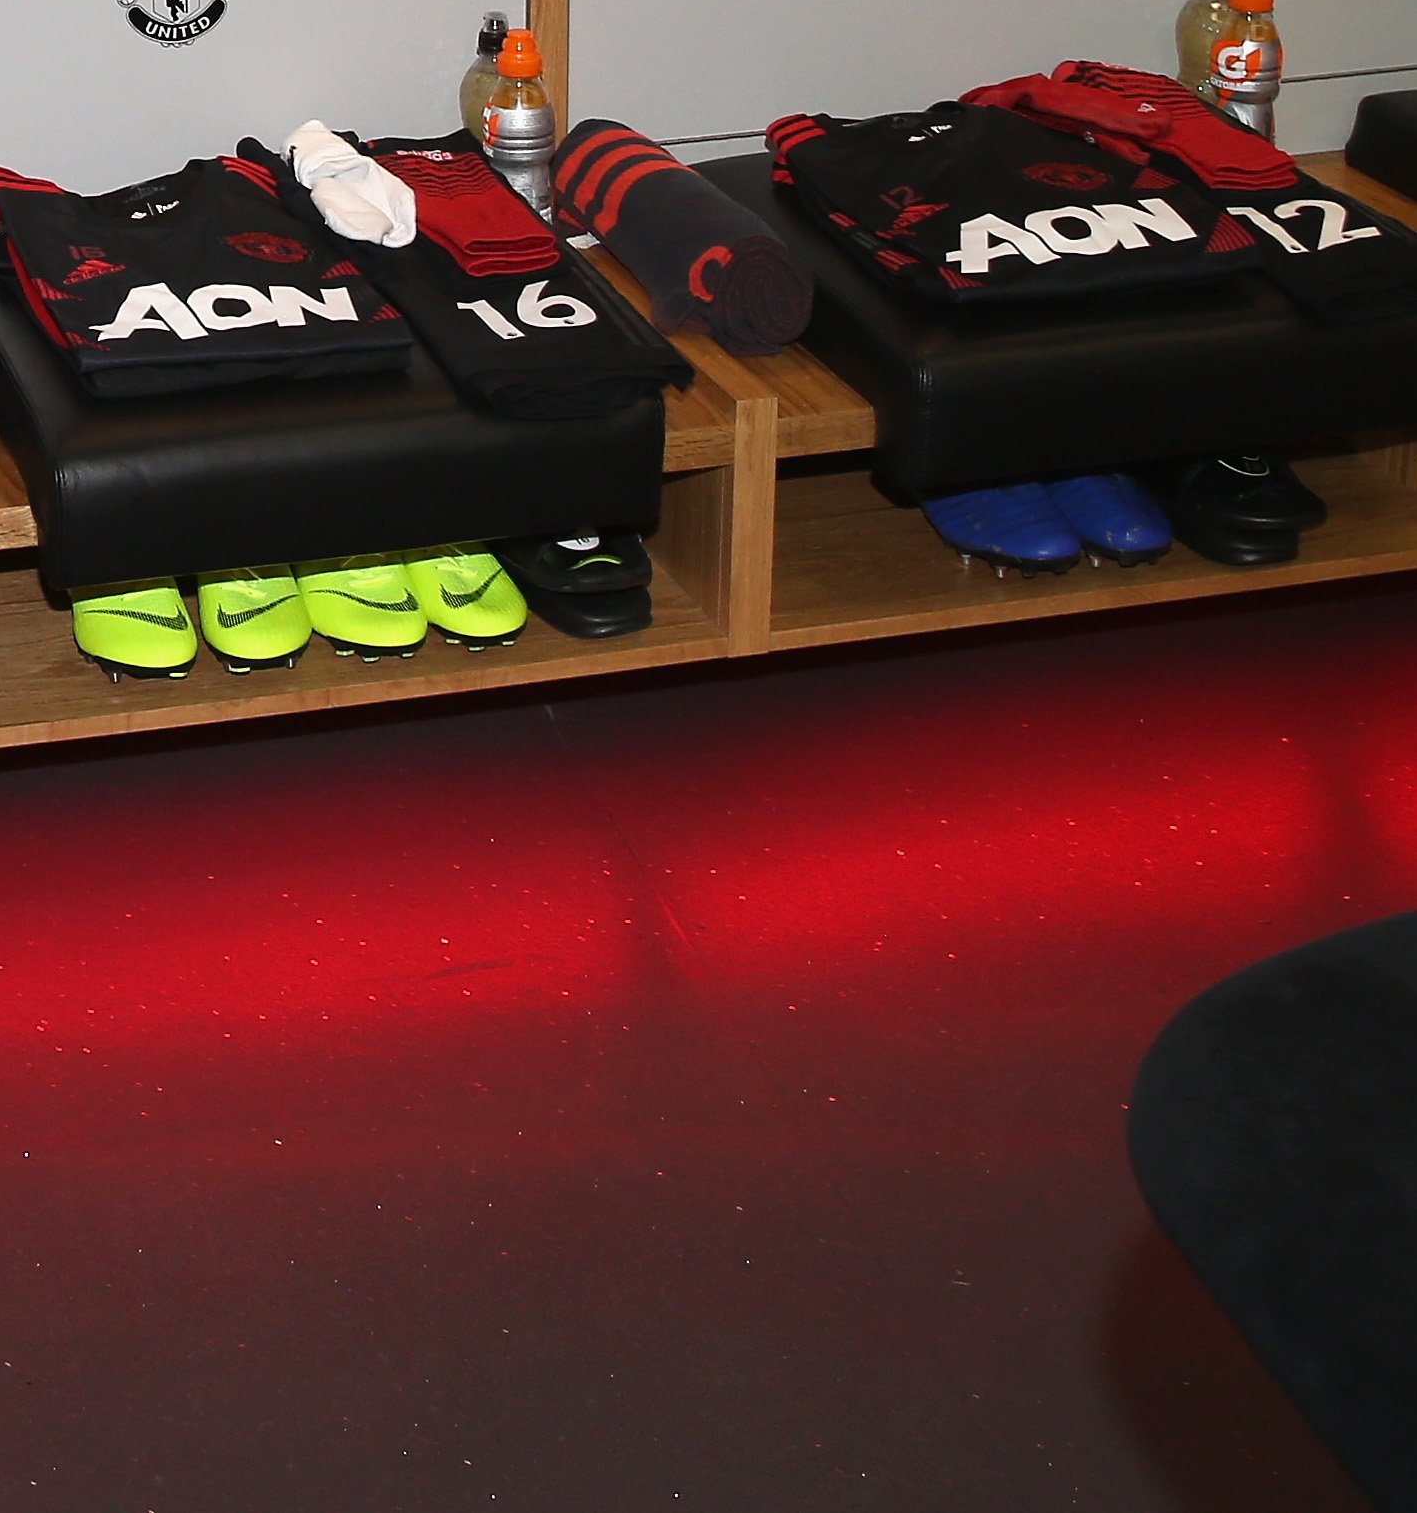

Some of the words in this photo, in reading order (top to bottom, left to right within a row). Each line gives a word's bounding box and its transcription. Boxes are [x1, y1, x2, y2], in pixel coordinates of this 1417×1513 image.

[145, 16, 210, 39] UNITED
[1217, 46, 1247, 79] G
[945, 197, 1198, 274] AON
[1226, 199, 1381, 254] 12
[88, 282, 359, 342] AON
[456, 279, 597, 340] 16
